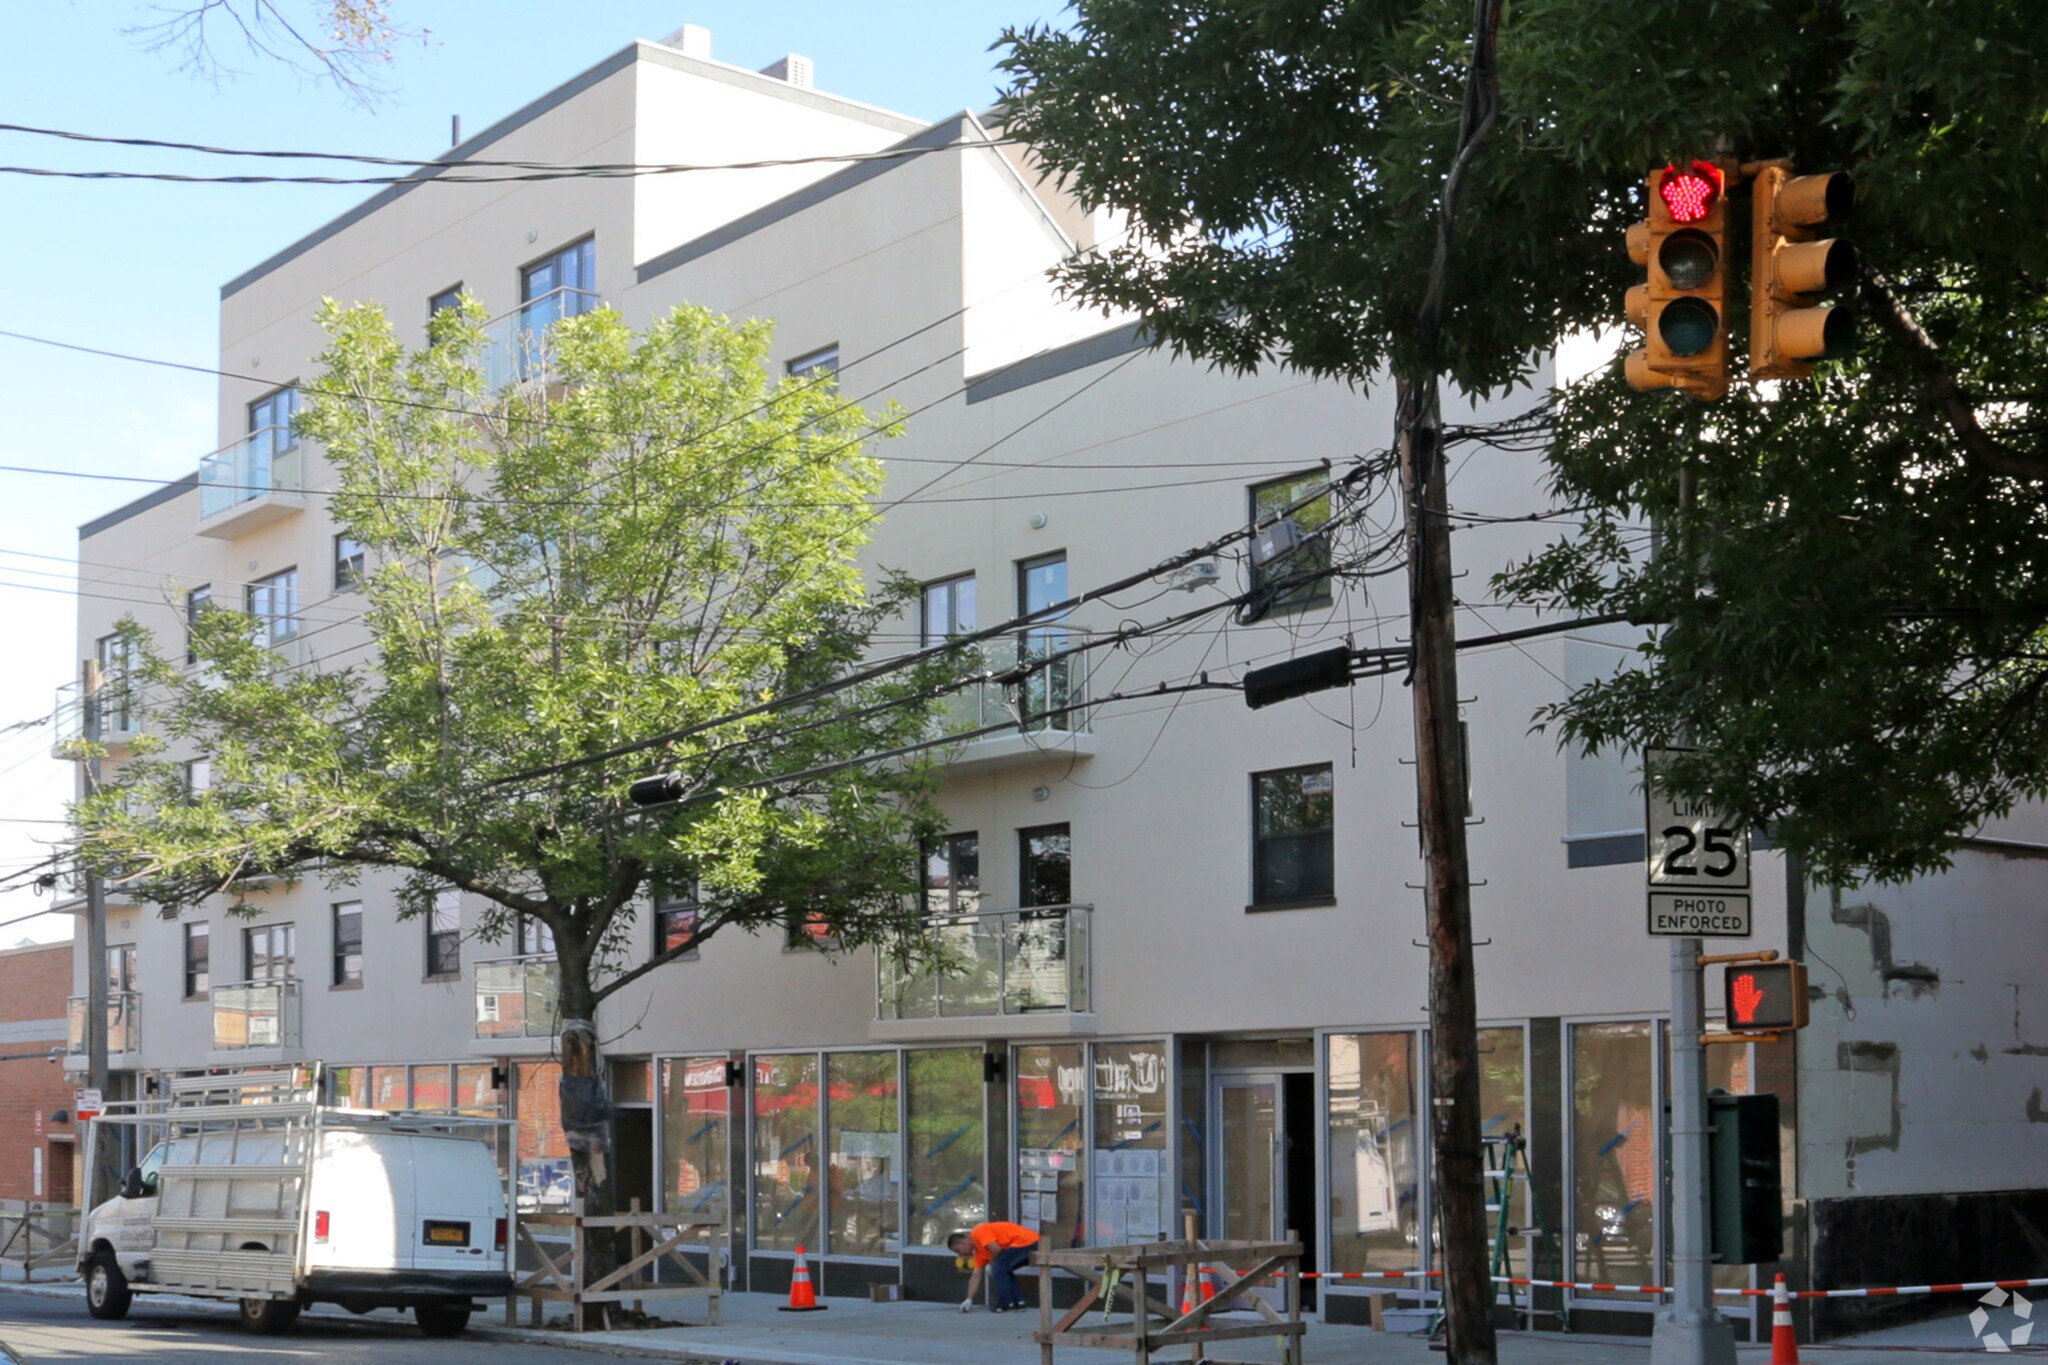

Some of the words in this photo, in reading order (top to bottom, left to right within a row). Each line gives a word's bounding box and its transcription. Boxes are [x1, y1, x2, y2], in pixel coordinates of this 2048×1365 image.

[1673, 800, 1717, 818] LIMI
[1662, 825, 1737, 877] 25
[1674, 899, 1726, 913] PHOTO
[1658, 915, 1742, 930] ENFORCED
